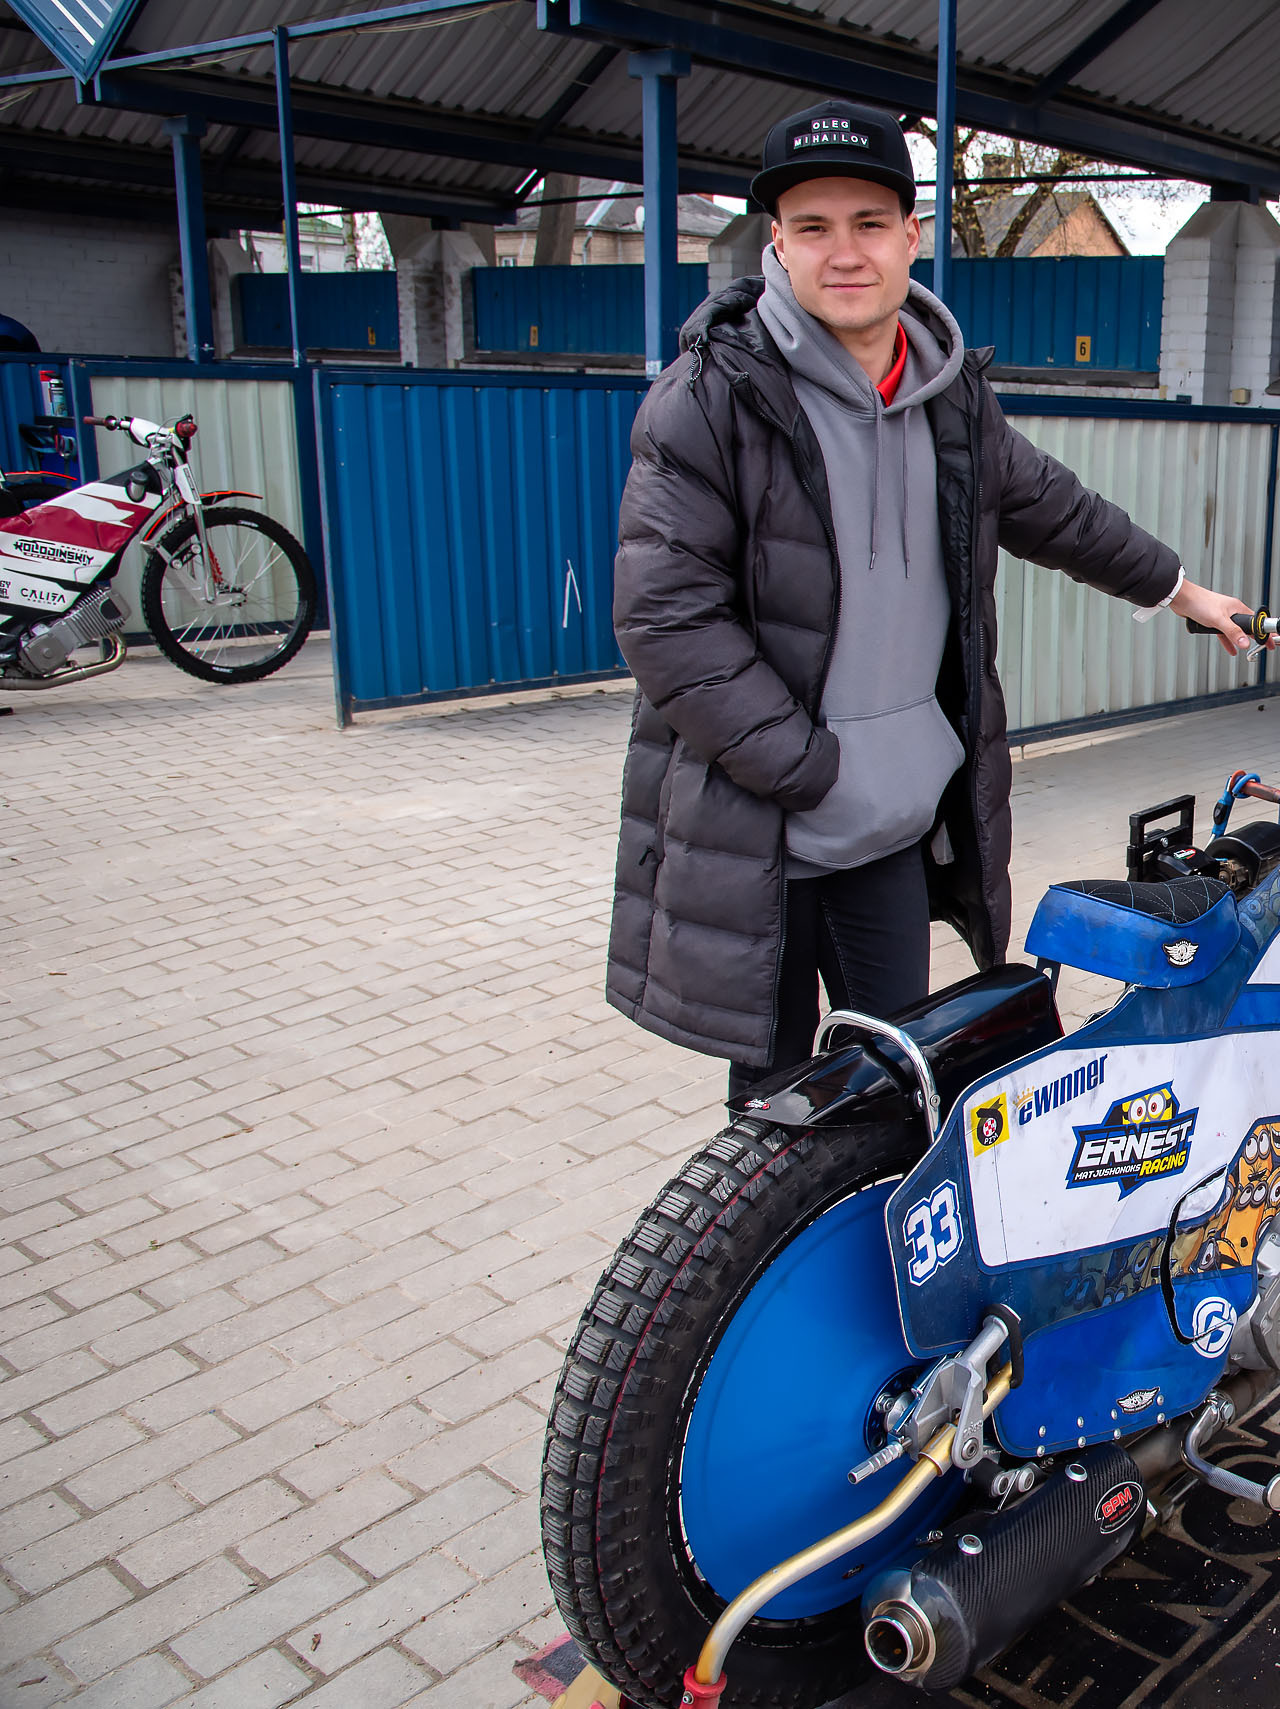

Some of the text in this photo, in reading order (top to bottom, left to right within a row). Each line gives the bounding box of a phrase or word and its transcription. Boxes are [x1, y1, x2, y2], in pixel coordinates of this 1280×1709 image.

[812, 119, 849, 130] OLEG
[794, 133, 868, 147] MIHAILOV
[1080, 342, 1087, 356] 6
[1077, 1120, 1192, 1168] ERNEST
[1074, 1151, 1187, 1180] MATJUSHONOKS RACING
[903, 1179, 963, 1286] 33
[1102, 1486, 1133, 1519] GPM
